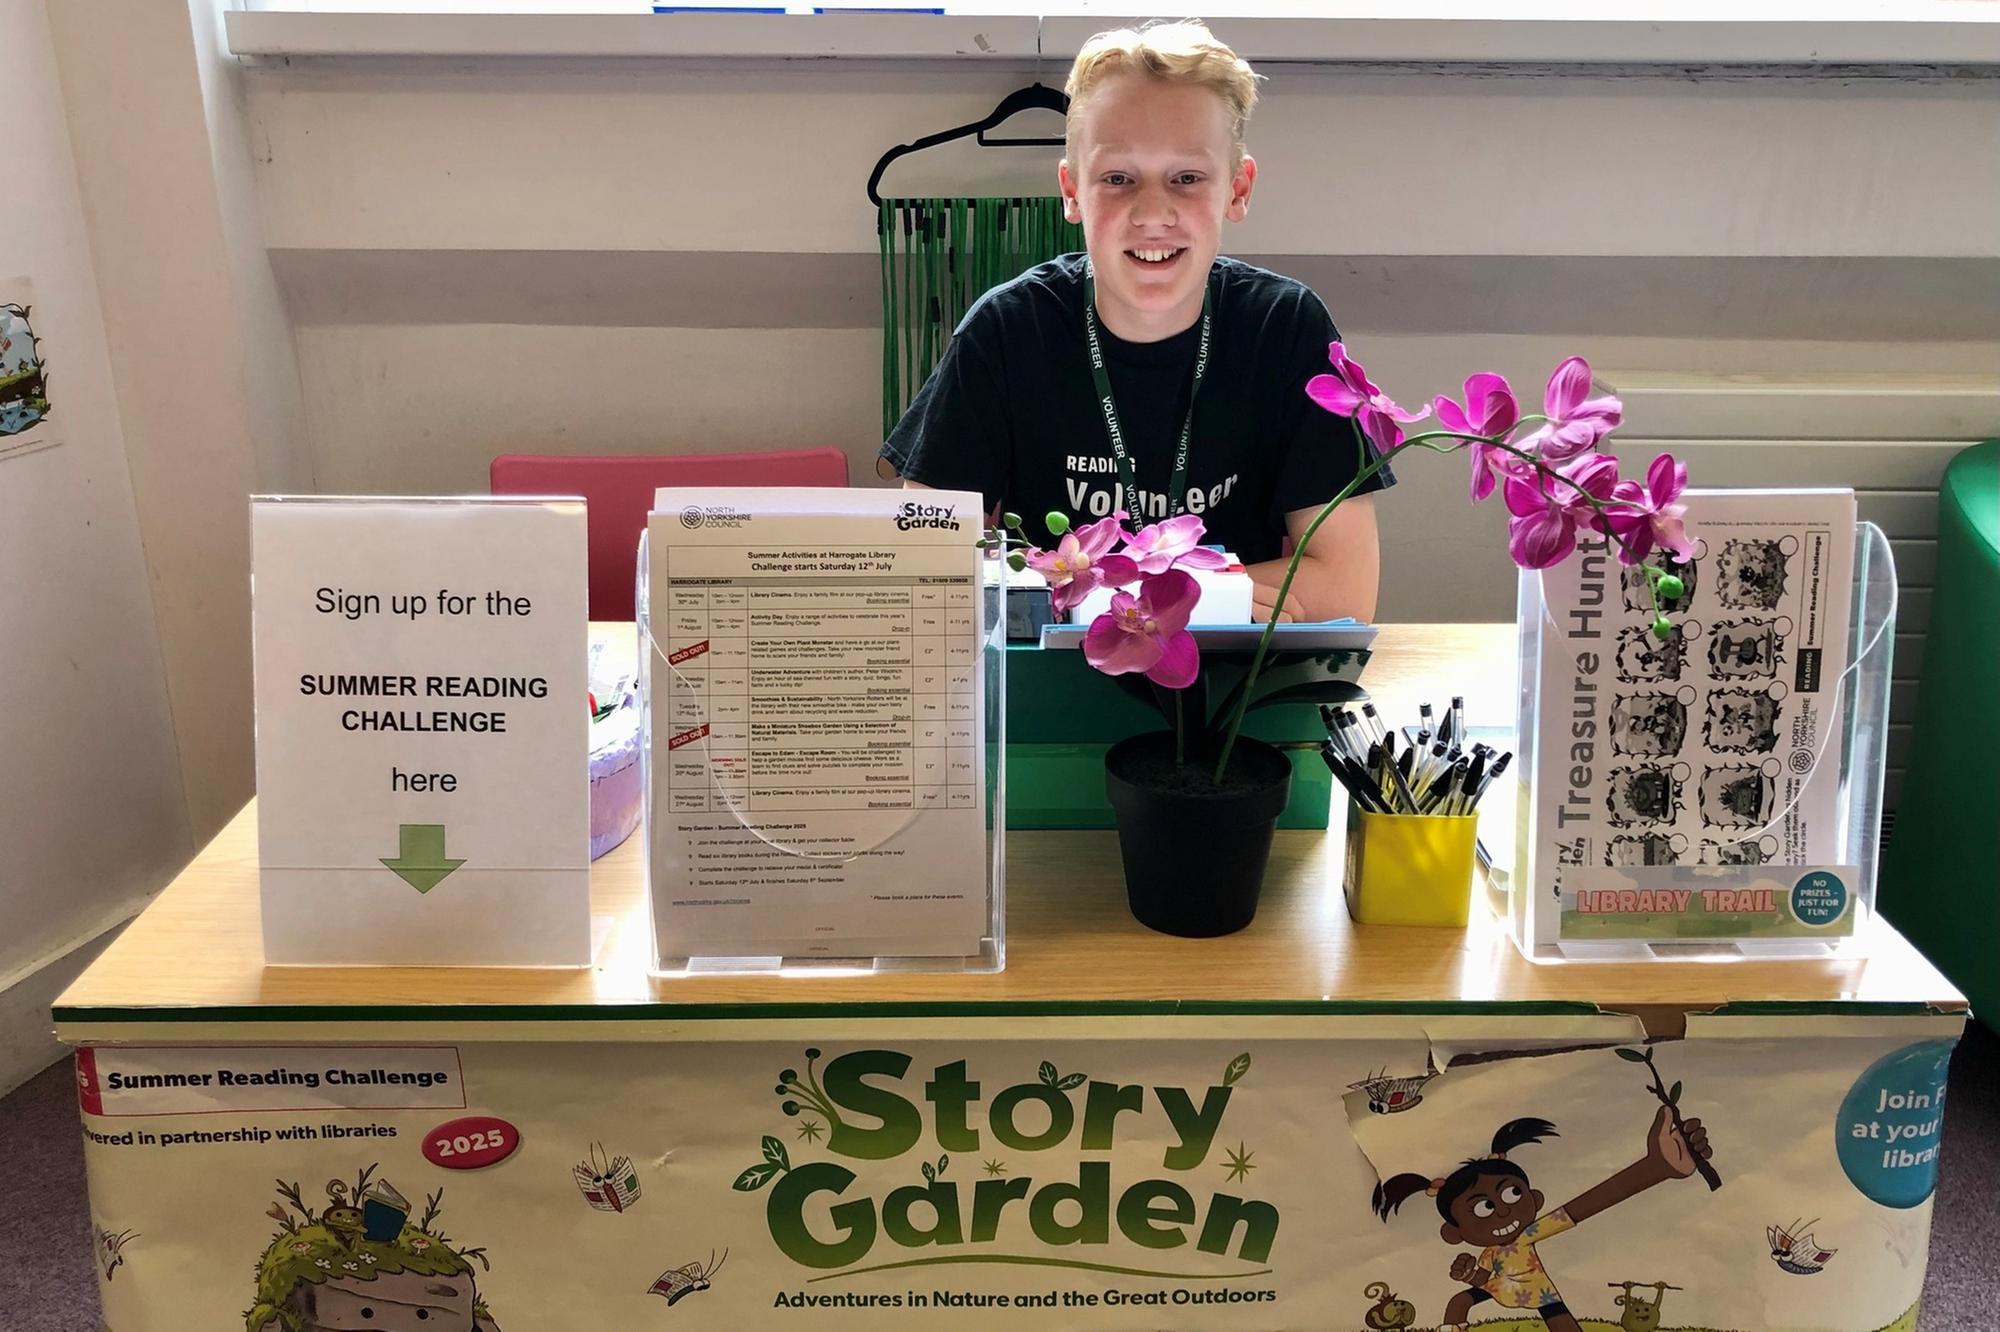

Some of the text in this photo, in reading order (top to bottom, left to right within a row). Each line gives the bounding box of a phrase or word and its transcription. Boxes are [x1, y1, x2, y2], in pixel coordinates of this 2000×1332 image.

[1086, 304, 1102, 369] VOLUNTEER
[1195, 315, 1210, 379] VOLUNTEER
[1103, 396, 1125, 459] VOLUNTEER
[904, 502, 954, 519] Story
[1126, 484, 1144, 532] VOLUNTE
[896, 517, 960, 531] Garden
[752, 563, 792, 572] Challenge
[819, 563, 856, 572] Saturday
[876, 562, 892, 572] July
[781, 551, 817, 559] Activities
[829, 551, 866, 560] Harrogate
[869, 551, 896, 560] Library
[1568, 537, 1607, 639] Hunt
[315, 588, 531, 620] Sign up for the
[1804, 536, 1822, 689] READING Summer Reading Challenge
[671, 650, 689, 662] SOLD
[300, 675, 548, 698] SUMMER READING
[342, 710, 506, 732] CHALLENGE
[1792, 716, 1800, 747] NORTH
[1800, 698, 1811, 747] YORKSHIRE
[1807, 708, 1818, 747] COUNCIL
[671, 734, 688, 746] SOLD
[1558, 651, 1600, 828] Treasure
[392, 768, 457, 792] here
[1800, 889, 1830, 897] PRIZES
[1813, 880, 1826, 888] NO
[1577, 889, 1777, 913] LIBRARY TRAIL
[1798, 899, 1818, 908] JUST
[1808, 908, 1828, 916] FUN!
[108, 1072, 212, 1089] Summer
[218, 1069, 320, 1089] Reading
[325, 1067, 448, 1086] Challenge
[822, 1049, 1233, 1171] Story
[1876, 1088, 1930, 1113] Join
[138, 1132, 156, 1144] in
[160, 1124, 272, 1149] partnership
[276, 1123, 317, 1144] with
[321, 1122, 397, 1141] libraries
[1852, 1119, 1939, 1143] at your
[435, 1129, 504, 1158] 2025
[1883, 1144, 1940, 1168] librar
[767, 1161, 1280, 1269] Garden
[774, 1287, 1276, 1308] Adventures in Nature and the Great Outdoors
